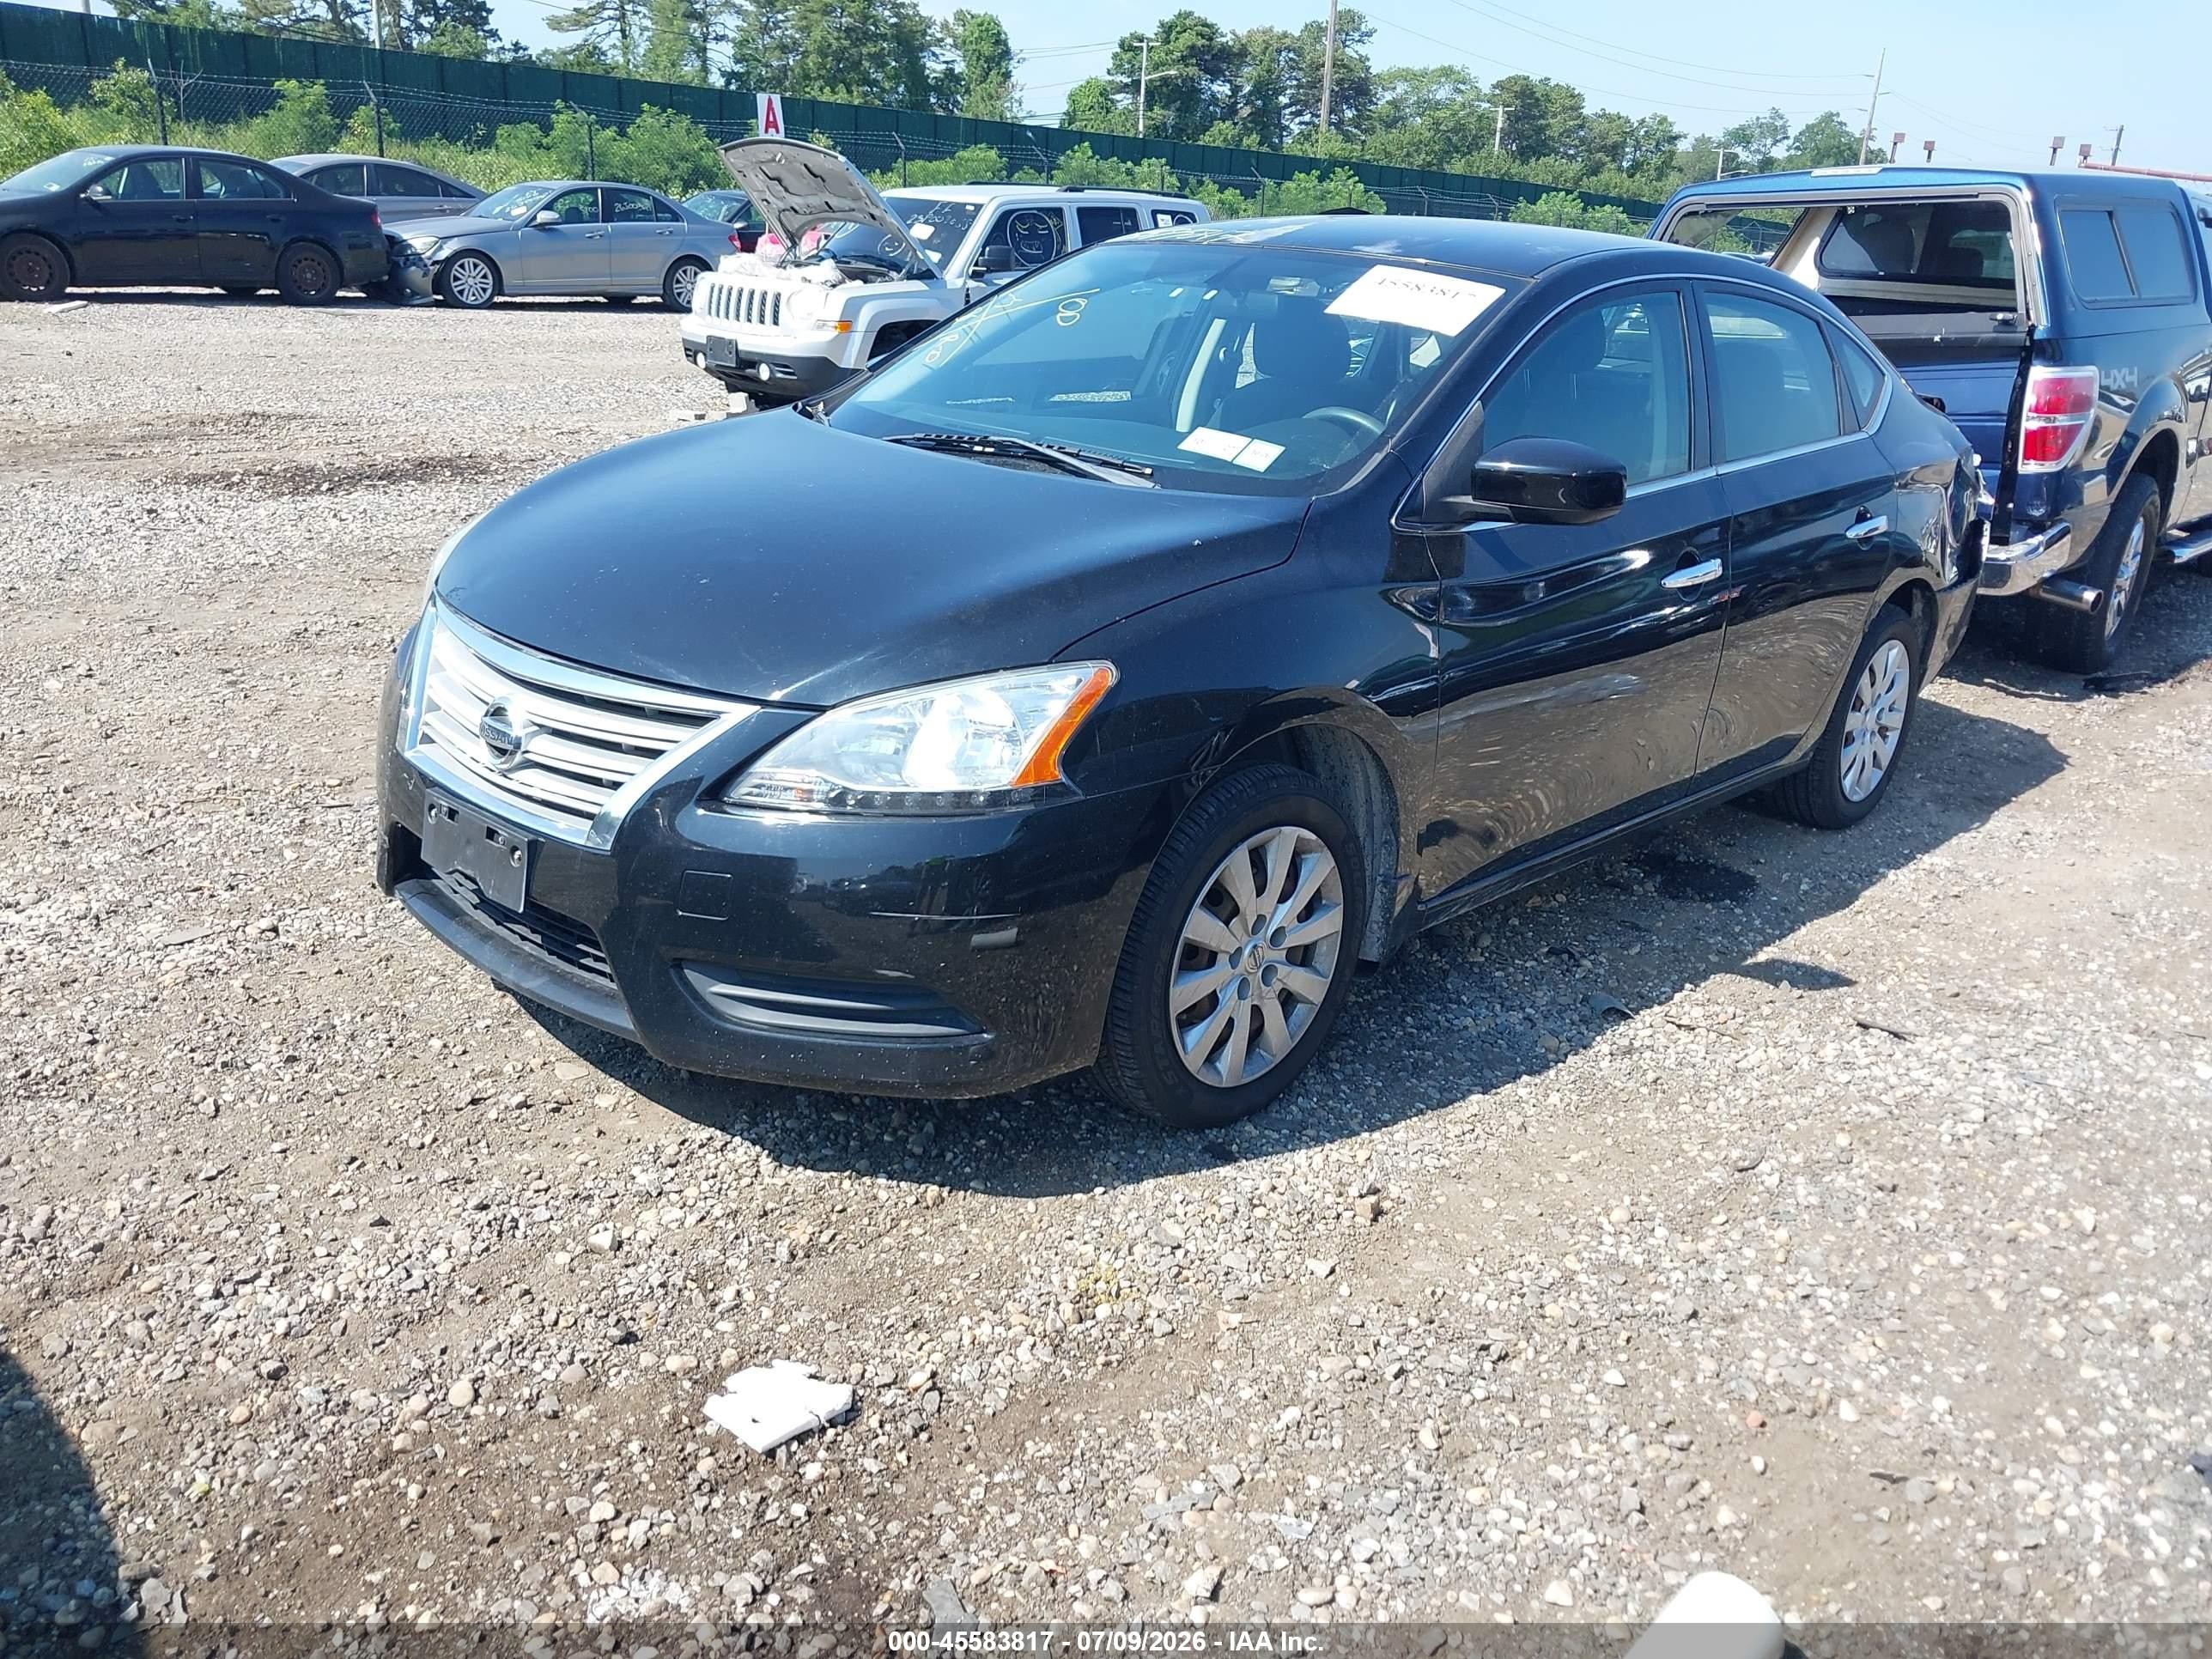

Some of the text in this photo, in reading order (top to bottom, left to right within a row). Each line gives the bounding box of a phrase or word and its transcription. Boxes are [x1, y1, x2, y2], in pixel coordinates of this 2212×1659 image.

[764, 95, 780, 134] A
[2100, 367, 2138, 391] 4X4
[481, 722, 514, 744] NISSAN
